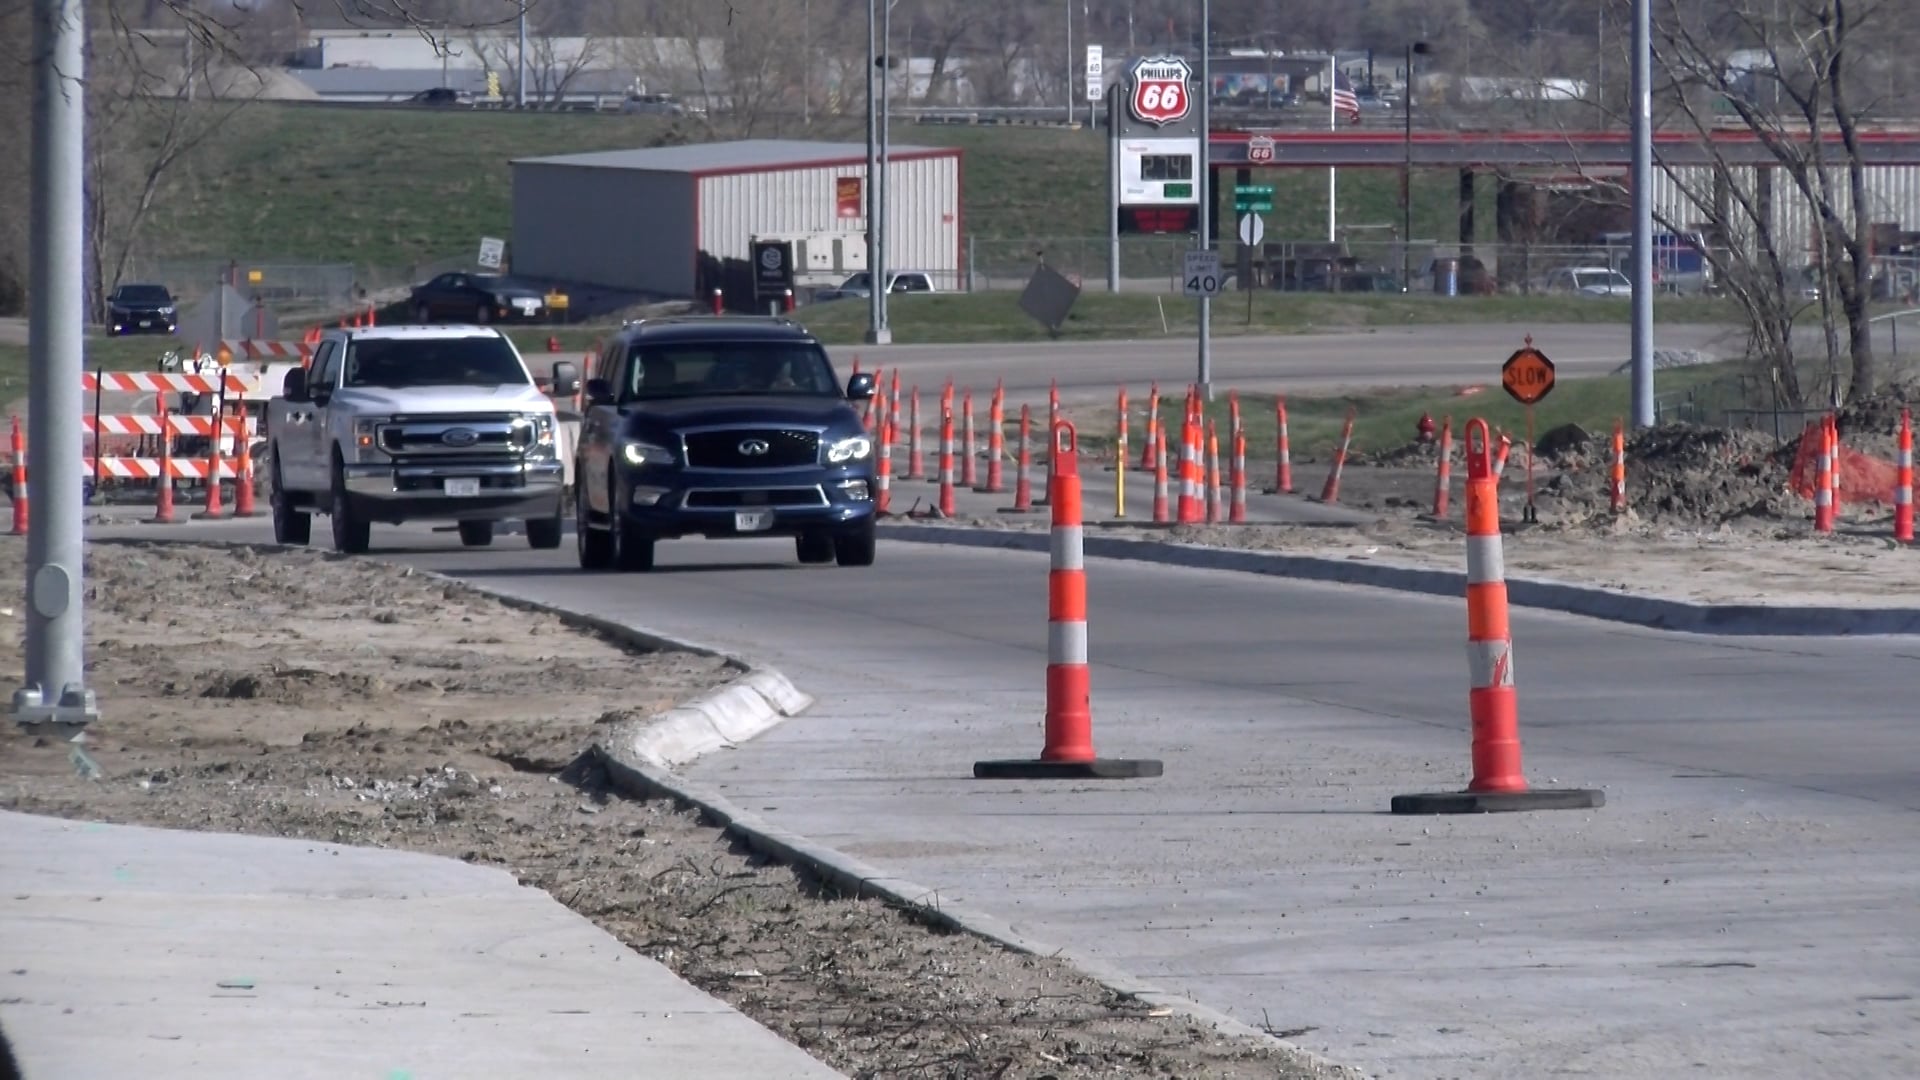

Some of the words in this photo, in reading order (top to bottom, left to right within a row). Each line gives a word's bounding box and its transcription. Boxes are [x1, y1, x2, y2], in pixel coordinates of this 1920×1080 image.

[1140, 67, 1183, 80] PHILLIPS
[1142, 84, 1180, 110] 66
[1252, 148, 1270, 159] 66
[1187, 254, 1217, 262] SPEED
[1189, 264, 1212, 273] LIMIT
[1187, 275, 1216, 292] 40
[1508, 366, 1547, 387] SLOW
